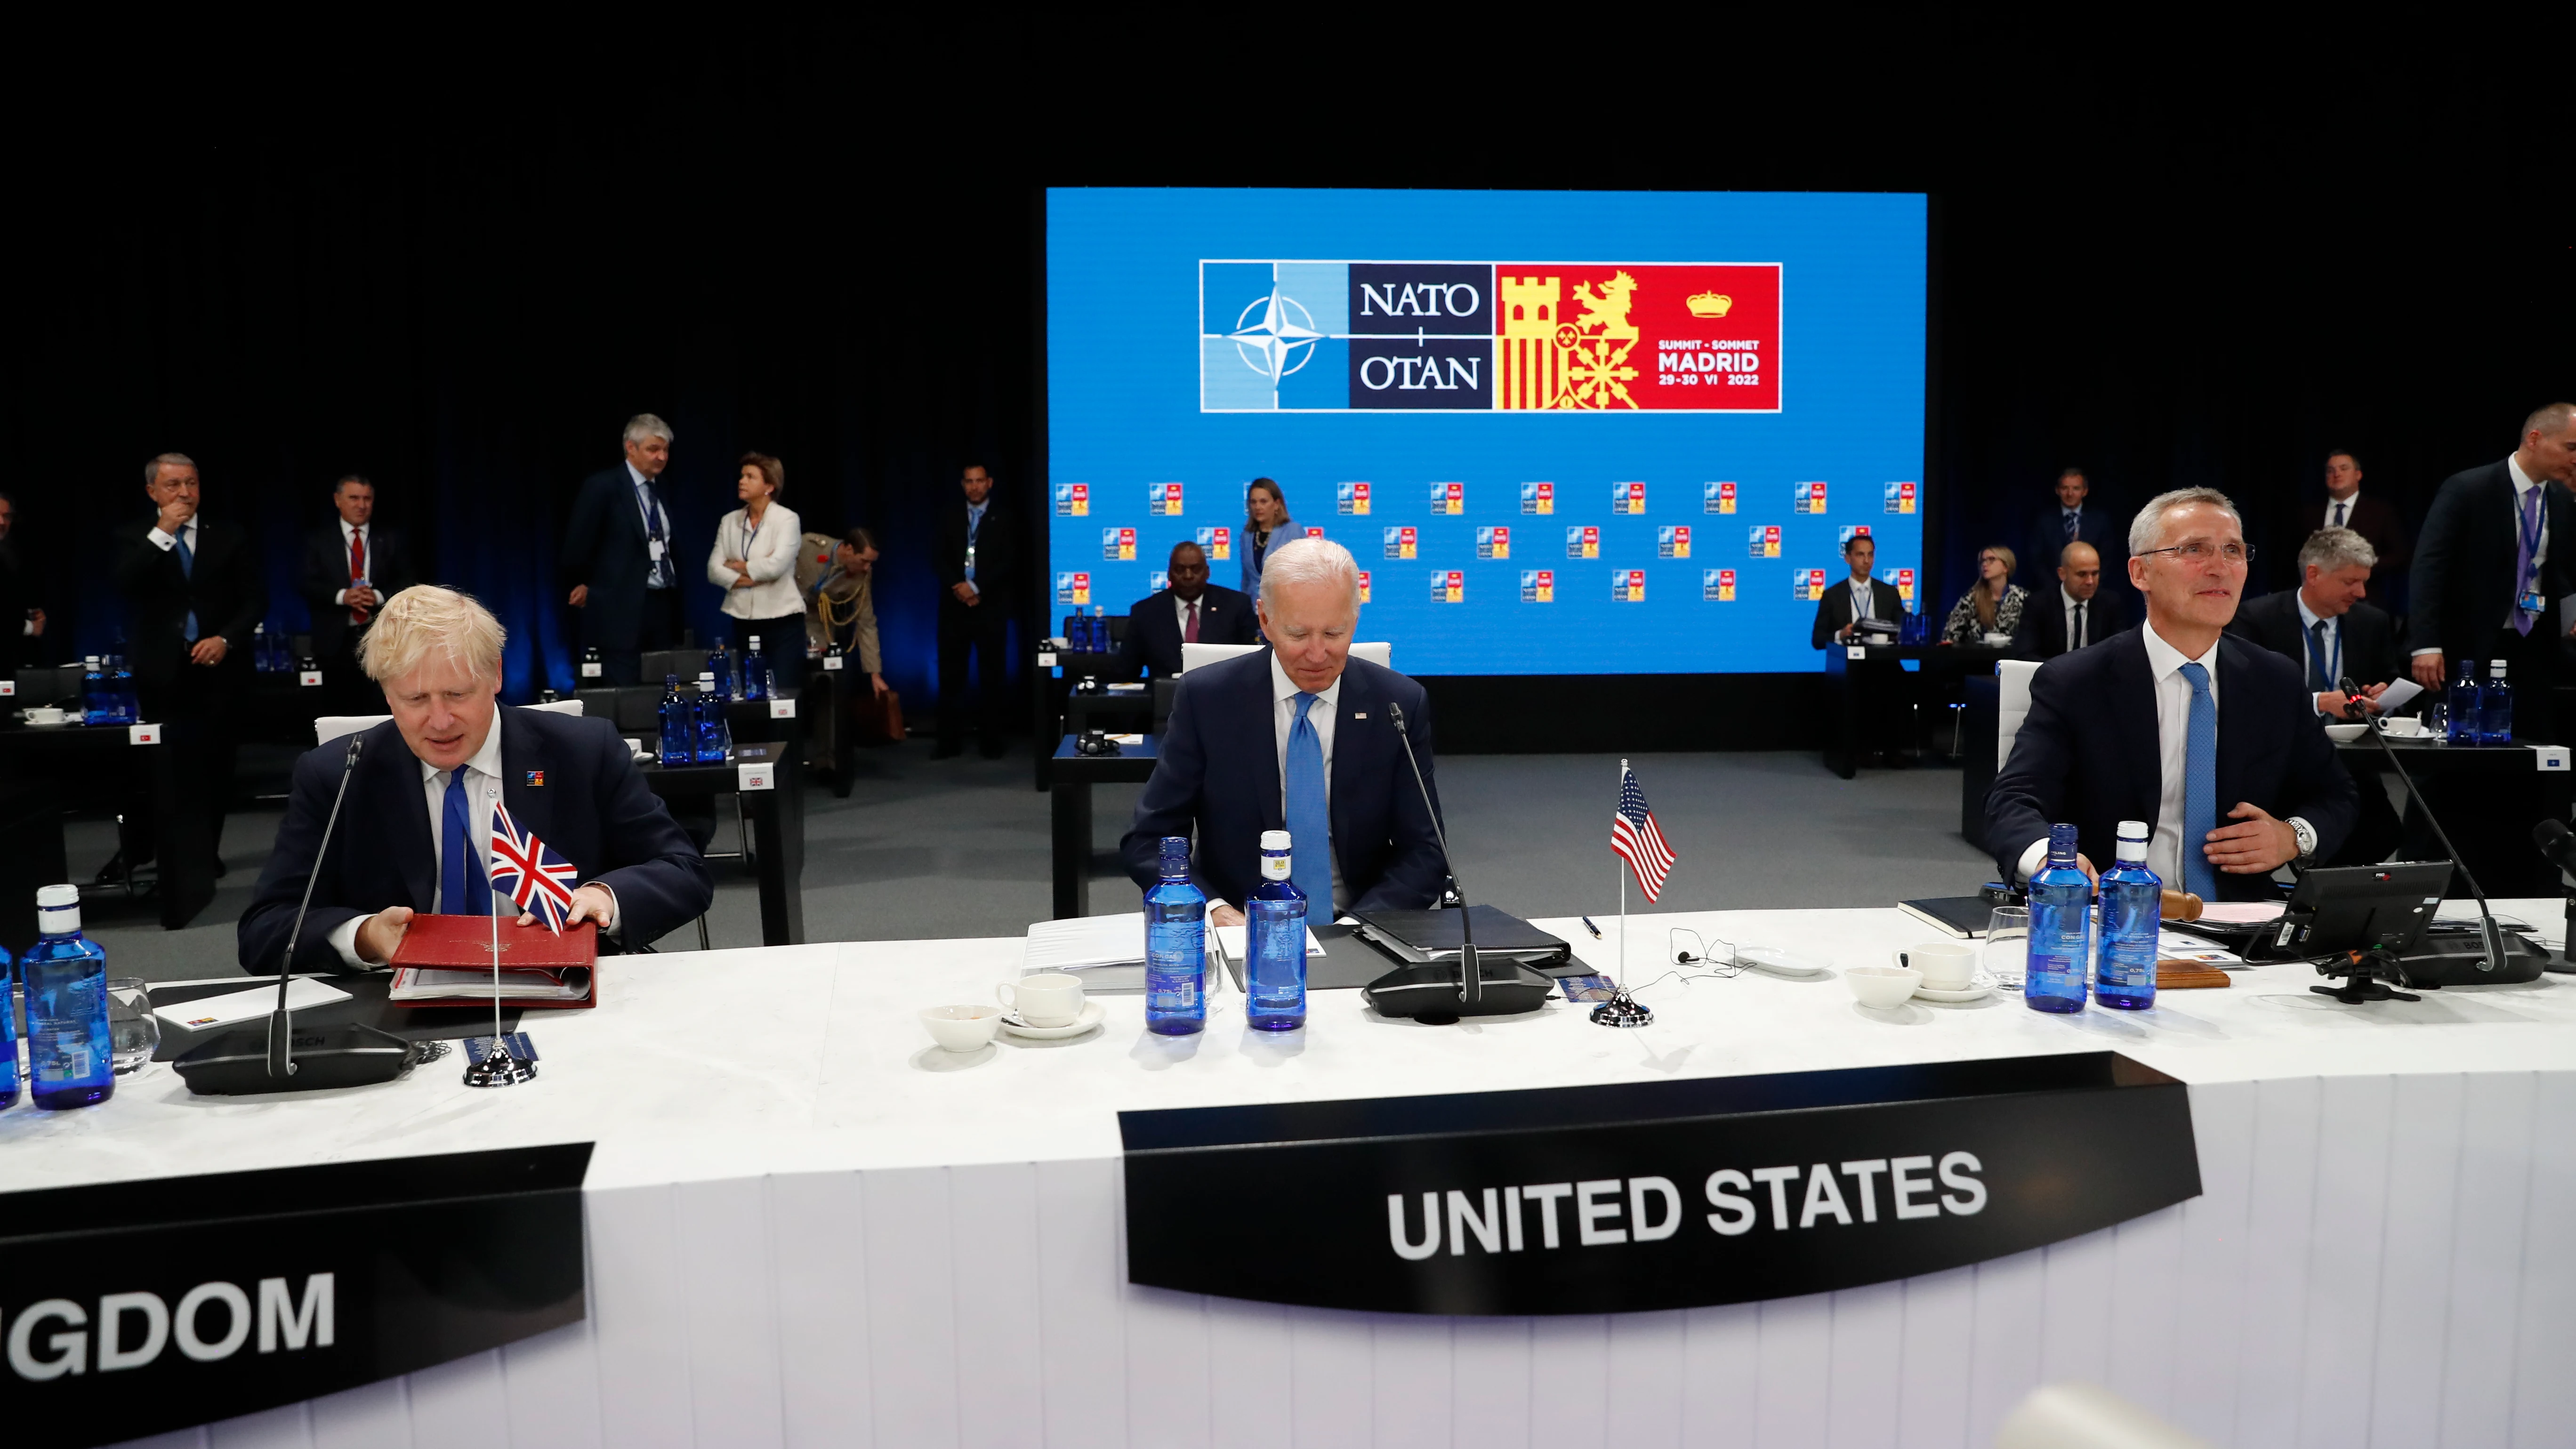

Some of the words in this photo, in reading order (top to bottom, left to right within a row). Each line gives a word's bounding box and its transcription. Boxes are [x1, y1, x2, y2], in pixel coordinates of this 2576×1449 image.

[1360, 282, 1479, 317] NATO
[1658, 339, 1703, 350] SUMMIT
[1711, 339, 1760, 350] SOMMET
[1658, 352, 1760, 372] MADRID
[1360, 356, 1481, 390] OTAN
[1658, 374, 1699, 386] 29-30
[1704, 374, 1718, 385] VI
[1727, 374, 1759, 386] 2022
[2463, 941, 2485, 949] BOS
[1452, 969, 1493, 978] BCH
[291, 1037, 325, 1047] SCH
[1387, 1176, 1682, 1261] UNITED
[1706, 1151, 1988, 1235] STATES
[0, 1272, 334, 1380] GDOM
